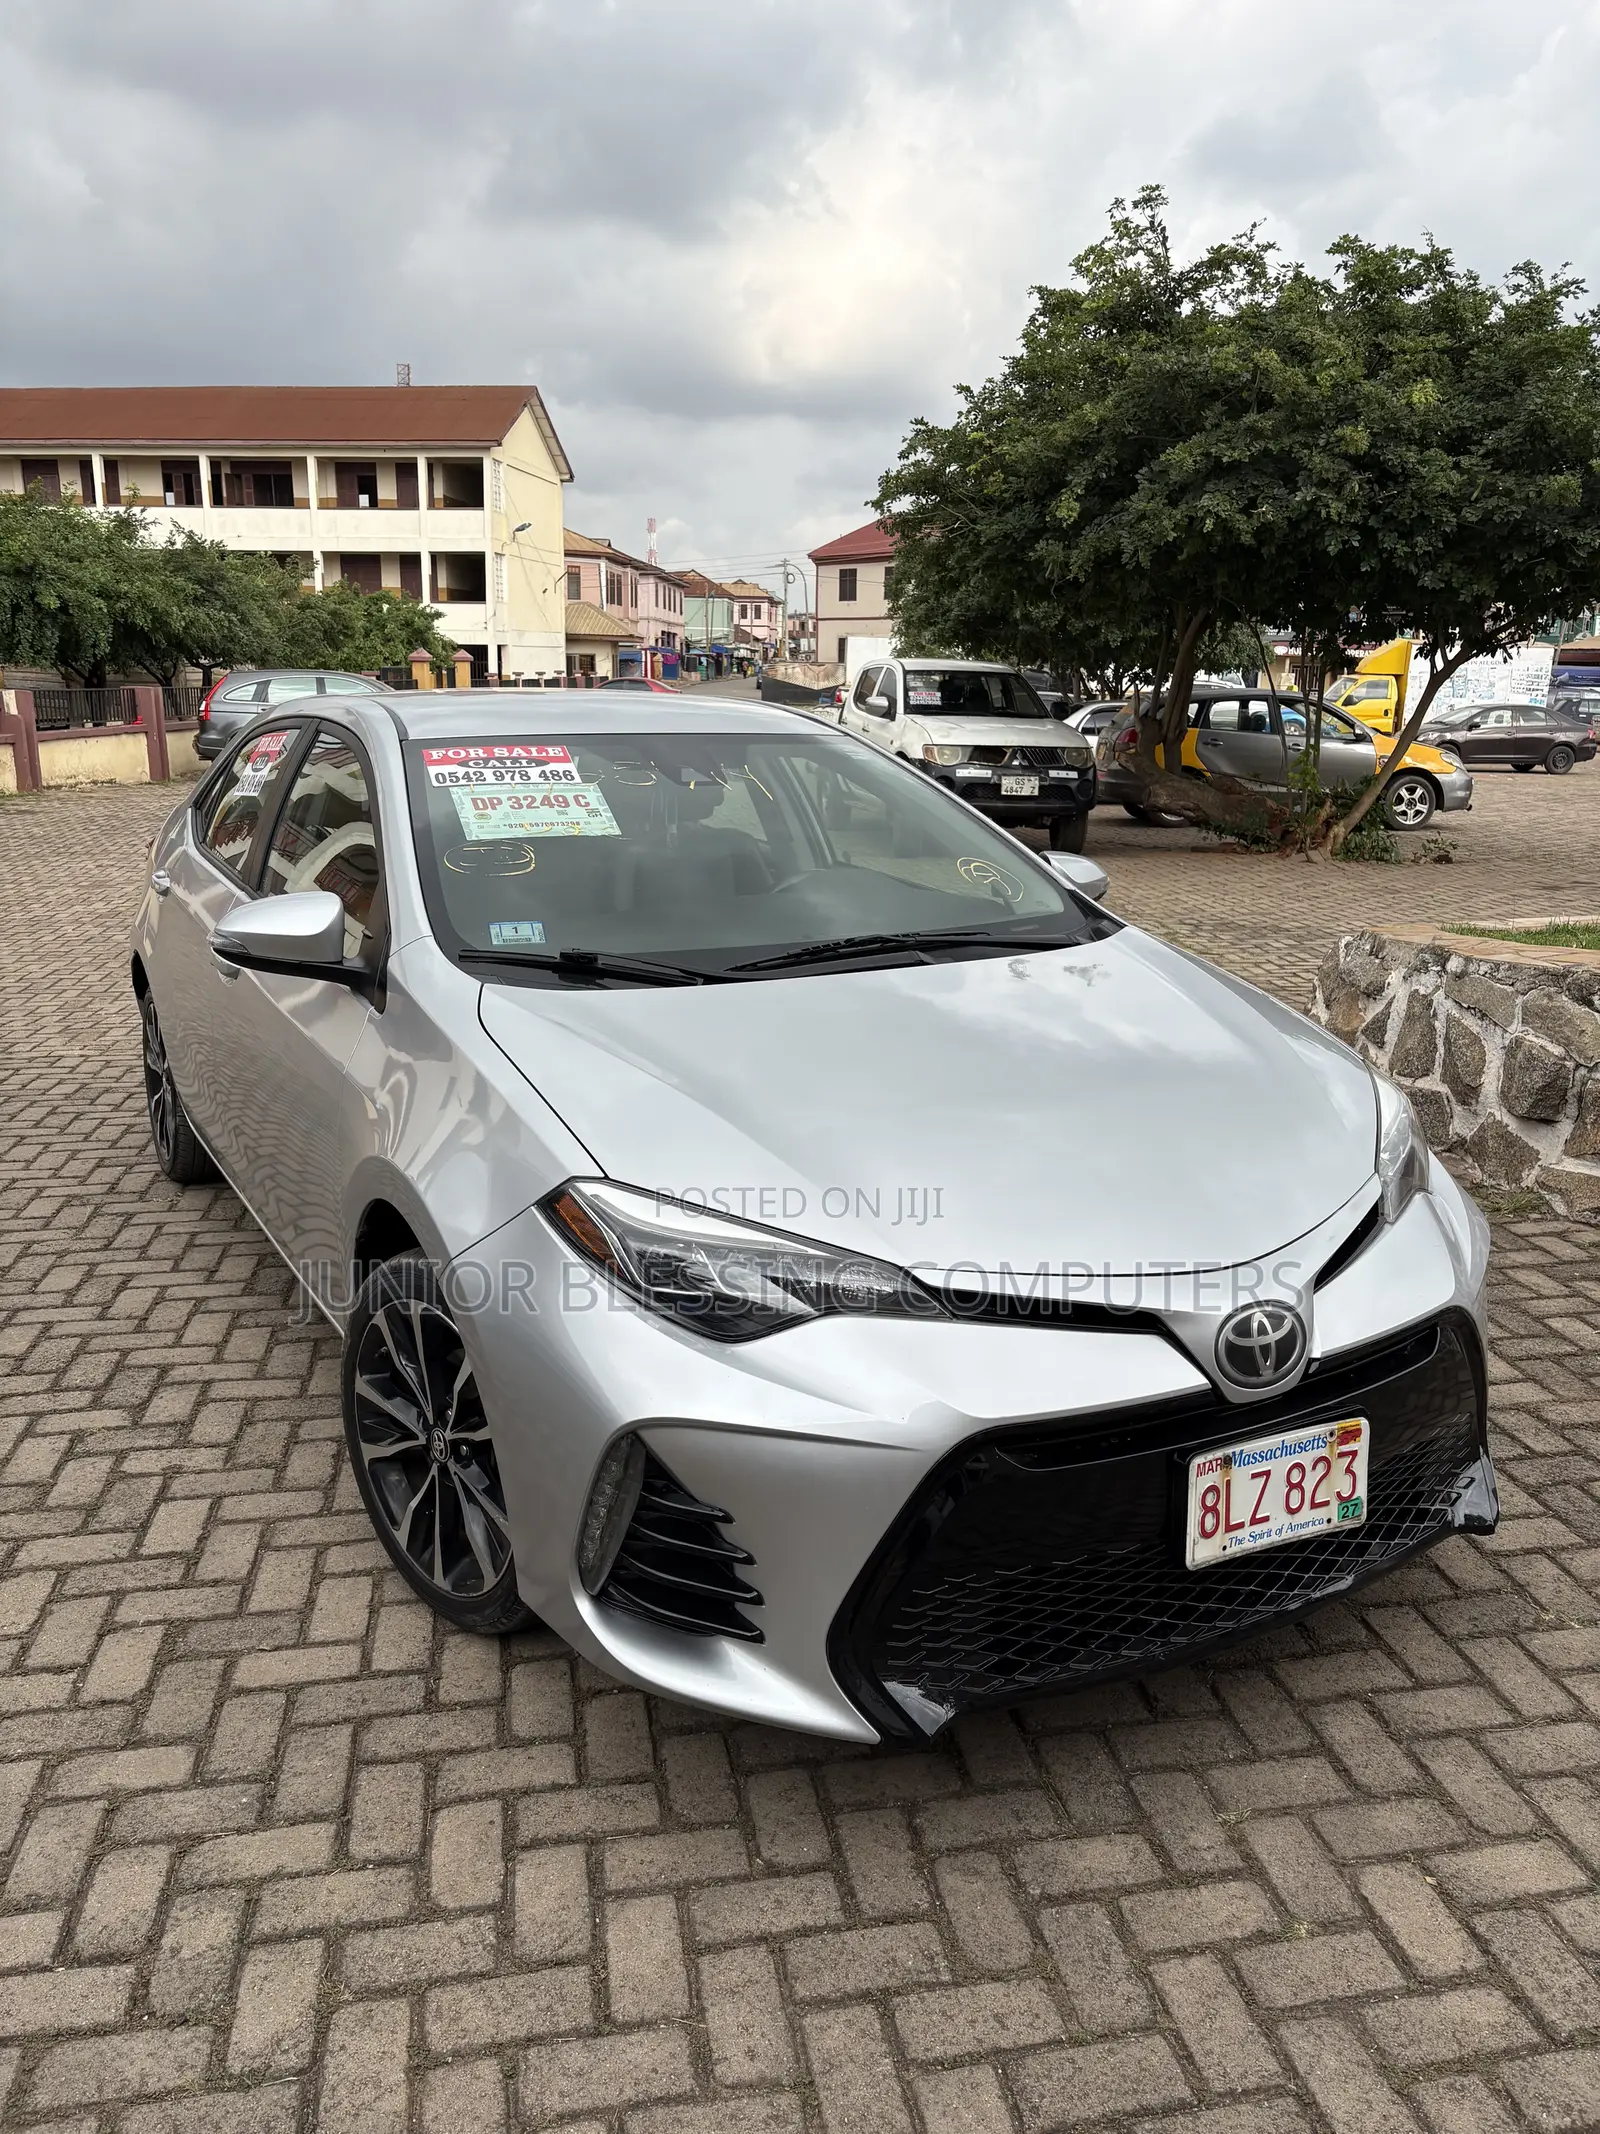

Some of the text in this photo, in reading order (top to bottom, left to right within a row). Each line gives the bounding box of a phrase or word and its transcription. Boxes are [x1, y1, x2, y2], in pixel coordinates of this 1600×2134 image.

[429, 746, 565, 760] FOR SALE
[468, 759, 536, 768] CALL
[434, 769, 575, 785] 0542 978 486
[1014, 777, 1026, 786] GS
[1030, 786, 1036, 794] Z
[470, 794, 591, 811] DP 3249 C
[1196, 1434, 1328, 1478] MAR Massachusetts
[1200, 1449, 1359, 1540] 8LZ 823
[1341, 1503, 1359, 1519] 27
[1228, 1517, 1324, 1549] The Spirit of America
